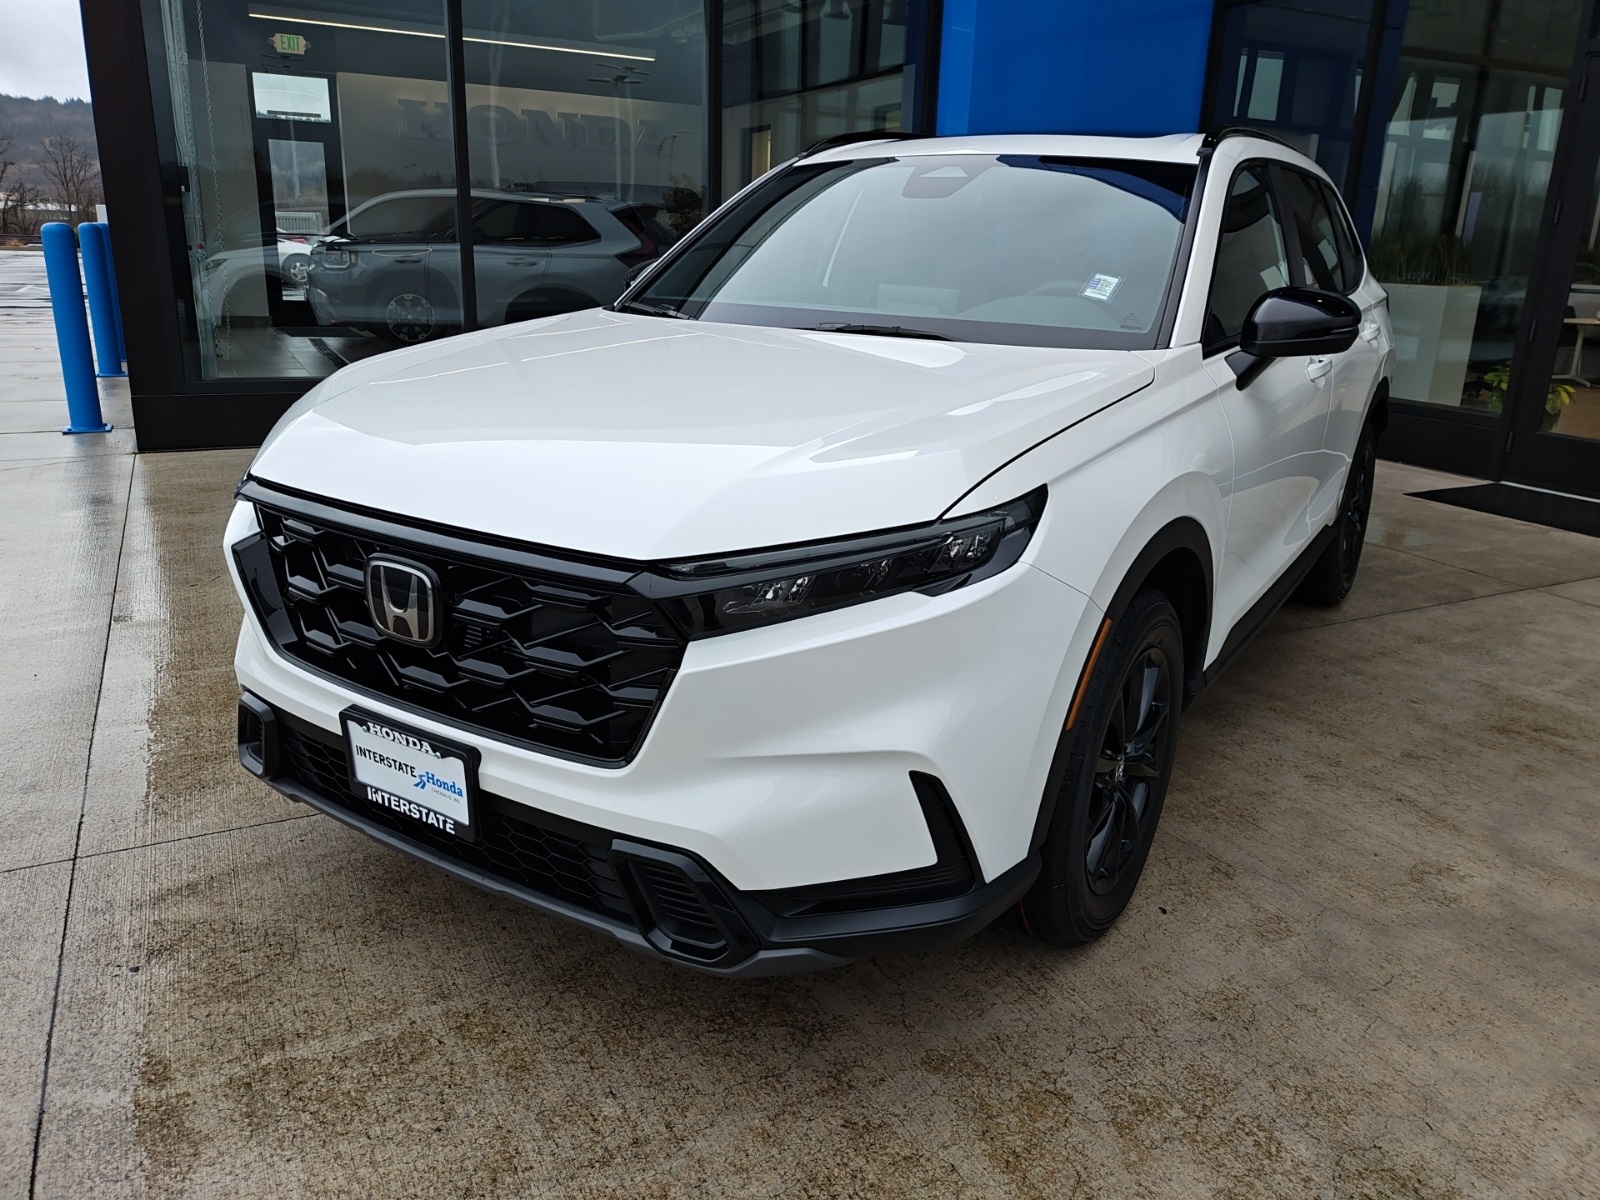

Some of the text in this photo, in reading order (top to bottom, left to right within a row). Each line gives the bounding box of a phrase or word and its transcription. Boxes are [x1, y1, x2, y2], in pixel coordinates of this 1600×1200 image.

[280, 35, 300, 52] EXIT
[397, 98, 672, 157] HONDA
[367, 722, 433, 756] HONDA
[355, 744, 463, 798] INTERSTATE Honda
[367, 786, 455, 835] INTERSTATE
